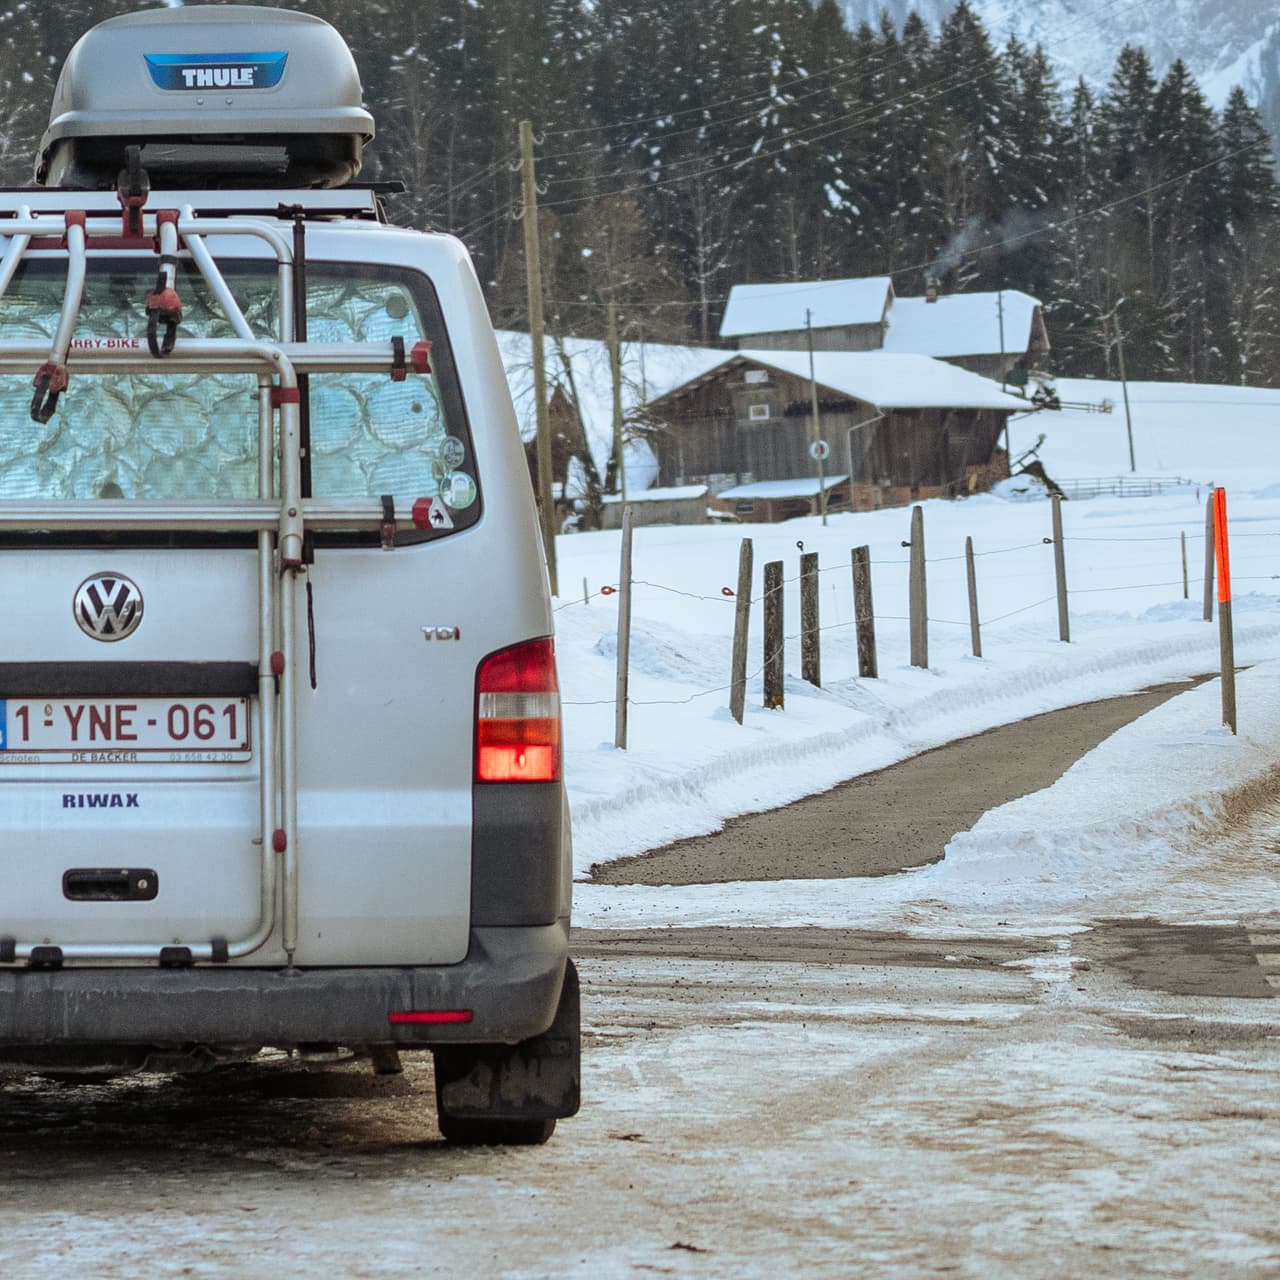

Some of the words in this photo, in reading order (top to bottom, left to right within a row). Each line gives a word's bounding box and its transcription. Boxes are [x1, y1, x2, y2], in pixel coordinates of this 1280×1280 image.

[181, 67, 254, 87] THULE
[420, 625, 461, 641] TDI
[71, 752, 88, 762] DE
[91, 752, 138, 762] BACKER
[61, 793, 140, 809] RIWAX
